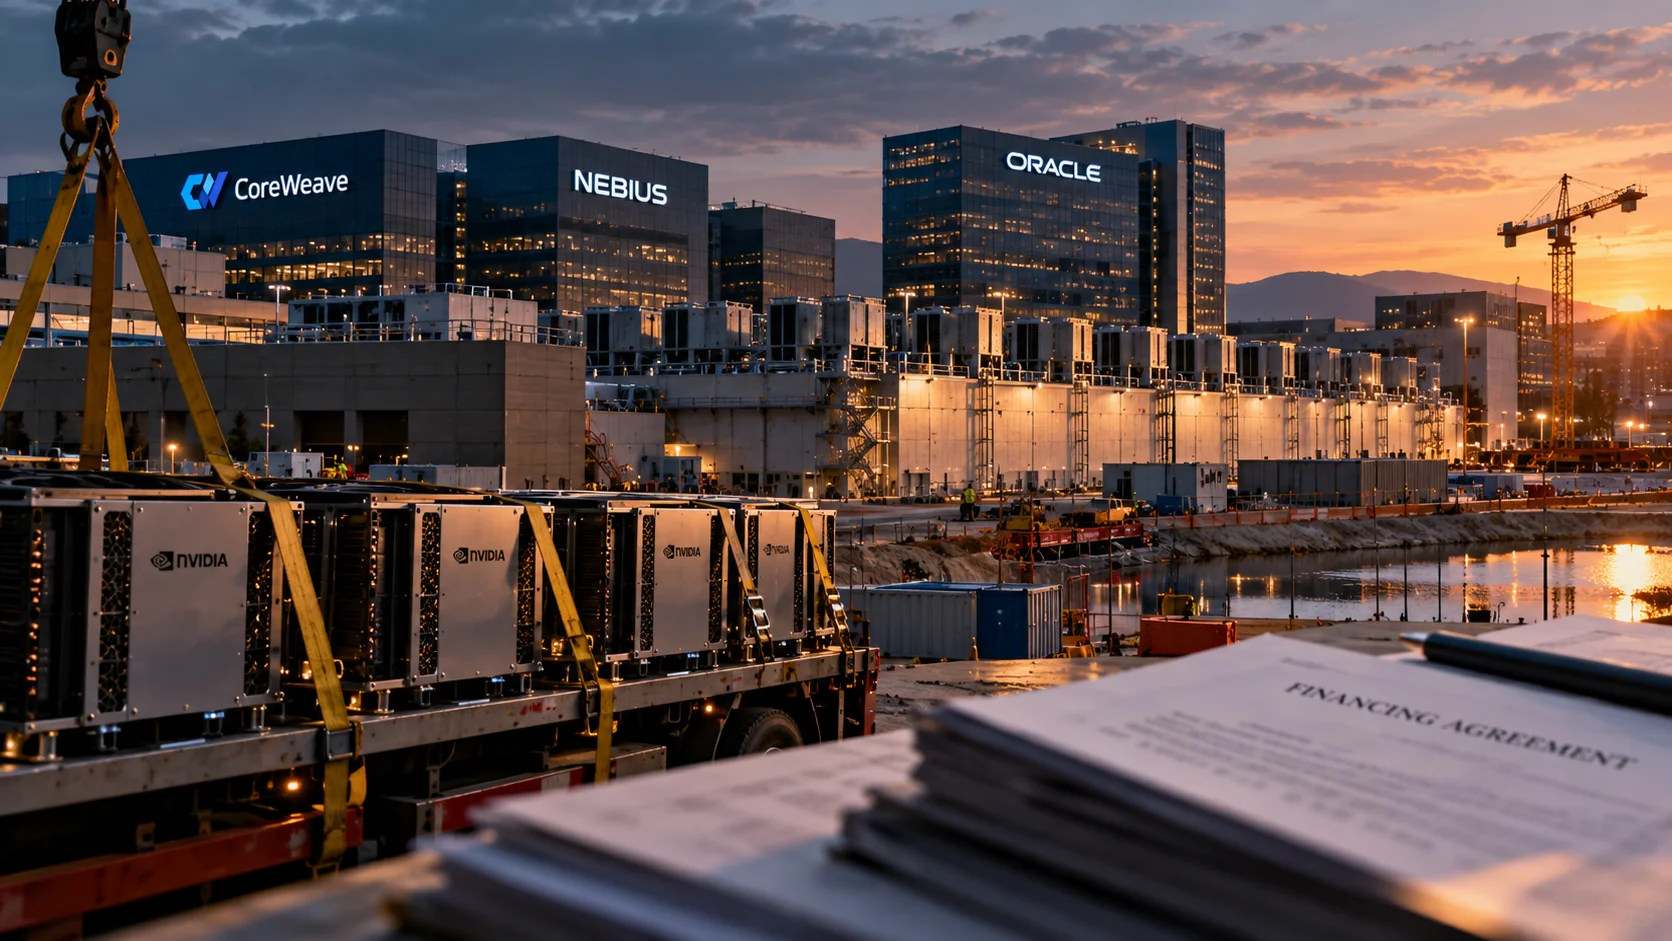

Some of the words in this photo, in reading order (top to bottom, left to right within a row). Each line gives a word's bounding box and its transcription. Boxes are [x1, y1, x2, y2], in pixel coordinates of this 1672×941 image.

[1006, 151, 1101, 183] ORACLE
[234, 173, 349, 200] CoreWeave
[574, 169, 668, 206] NEBIUS
[177, 553, 228, 568] NVIDIA
[470, 549, 506, 562] NVIDIA
[1285, 681, 1440, 726] FINANCING
[1441, 719, 1638, 771] AGREEMENT
